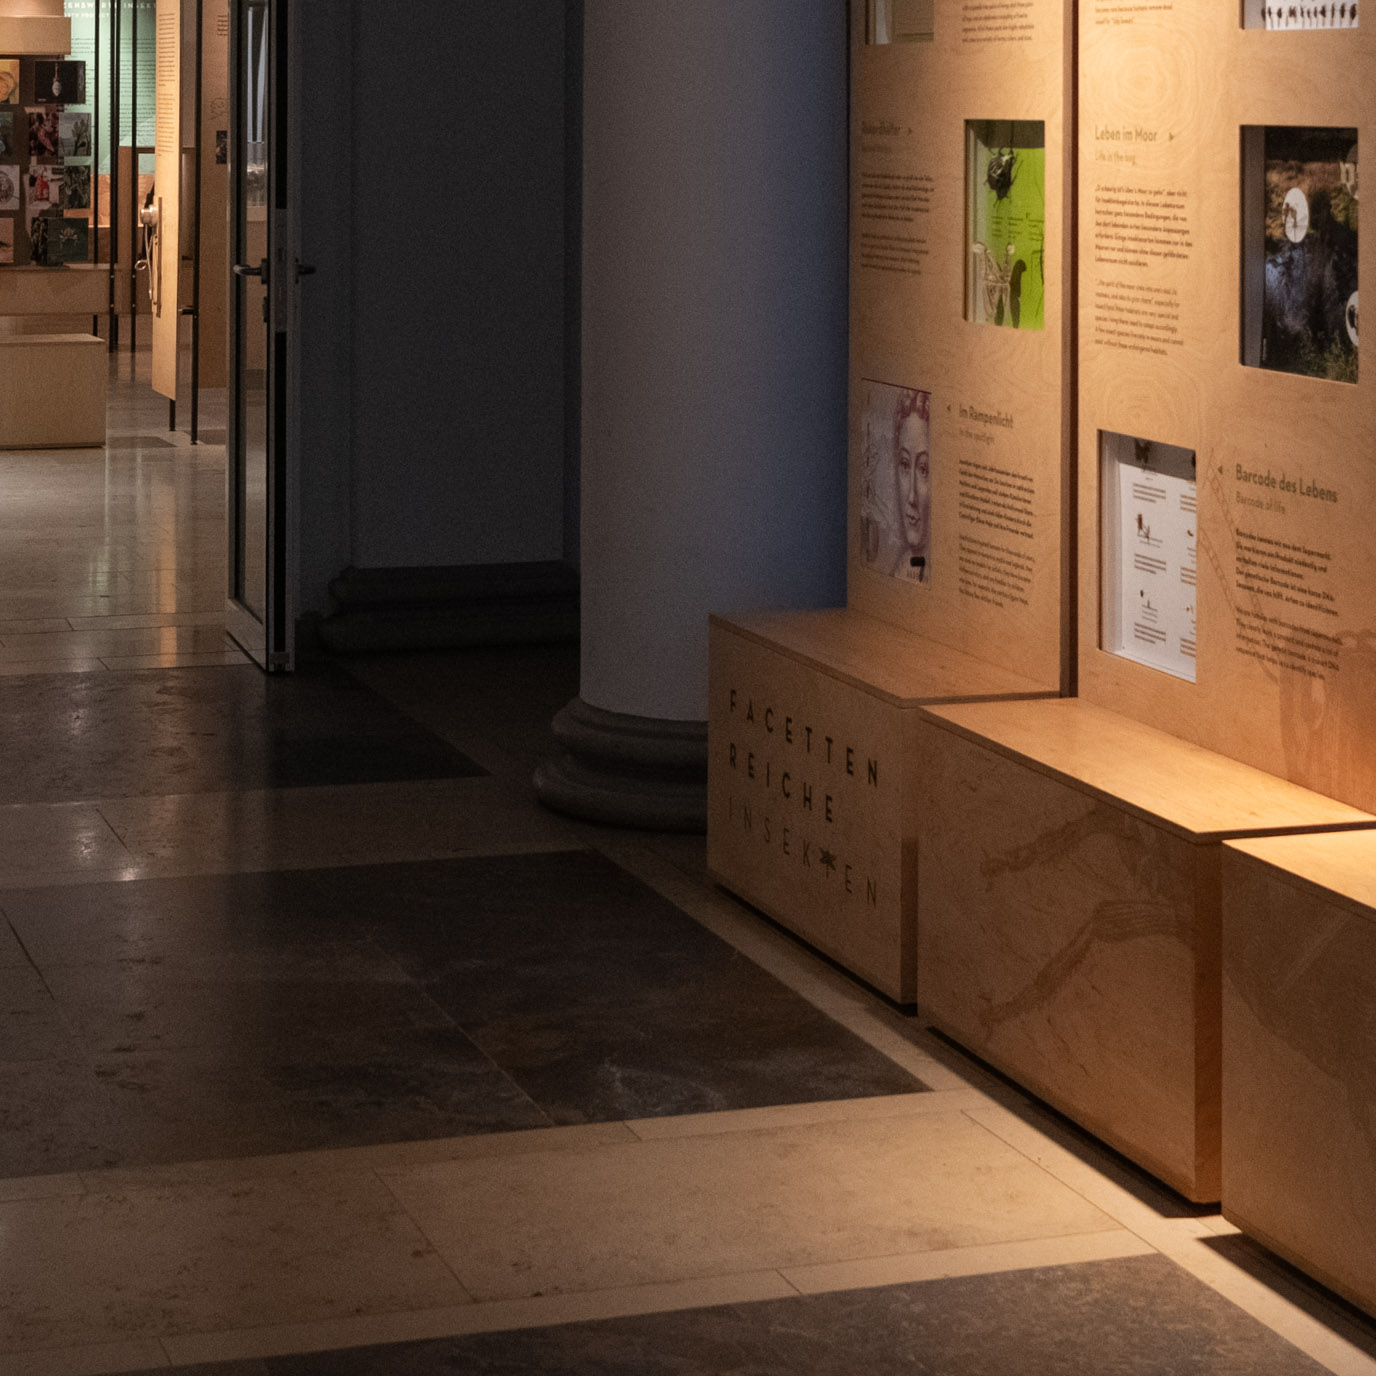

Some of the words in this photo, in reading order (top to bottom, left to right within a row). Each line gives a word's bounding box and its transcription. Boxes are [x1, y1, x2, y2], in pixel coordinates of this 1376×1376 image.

[1236, 463, 1276, 488] Barcode
[1279, 472, 1297, 494] des
[1299, 477, 1338, 503] Lebens
[730, 689, 878, 787] FACETTEN
[730, 742, 833, 823] REICHE
